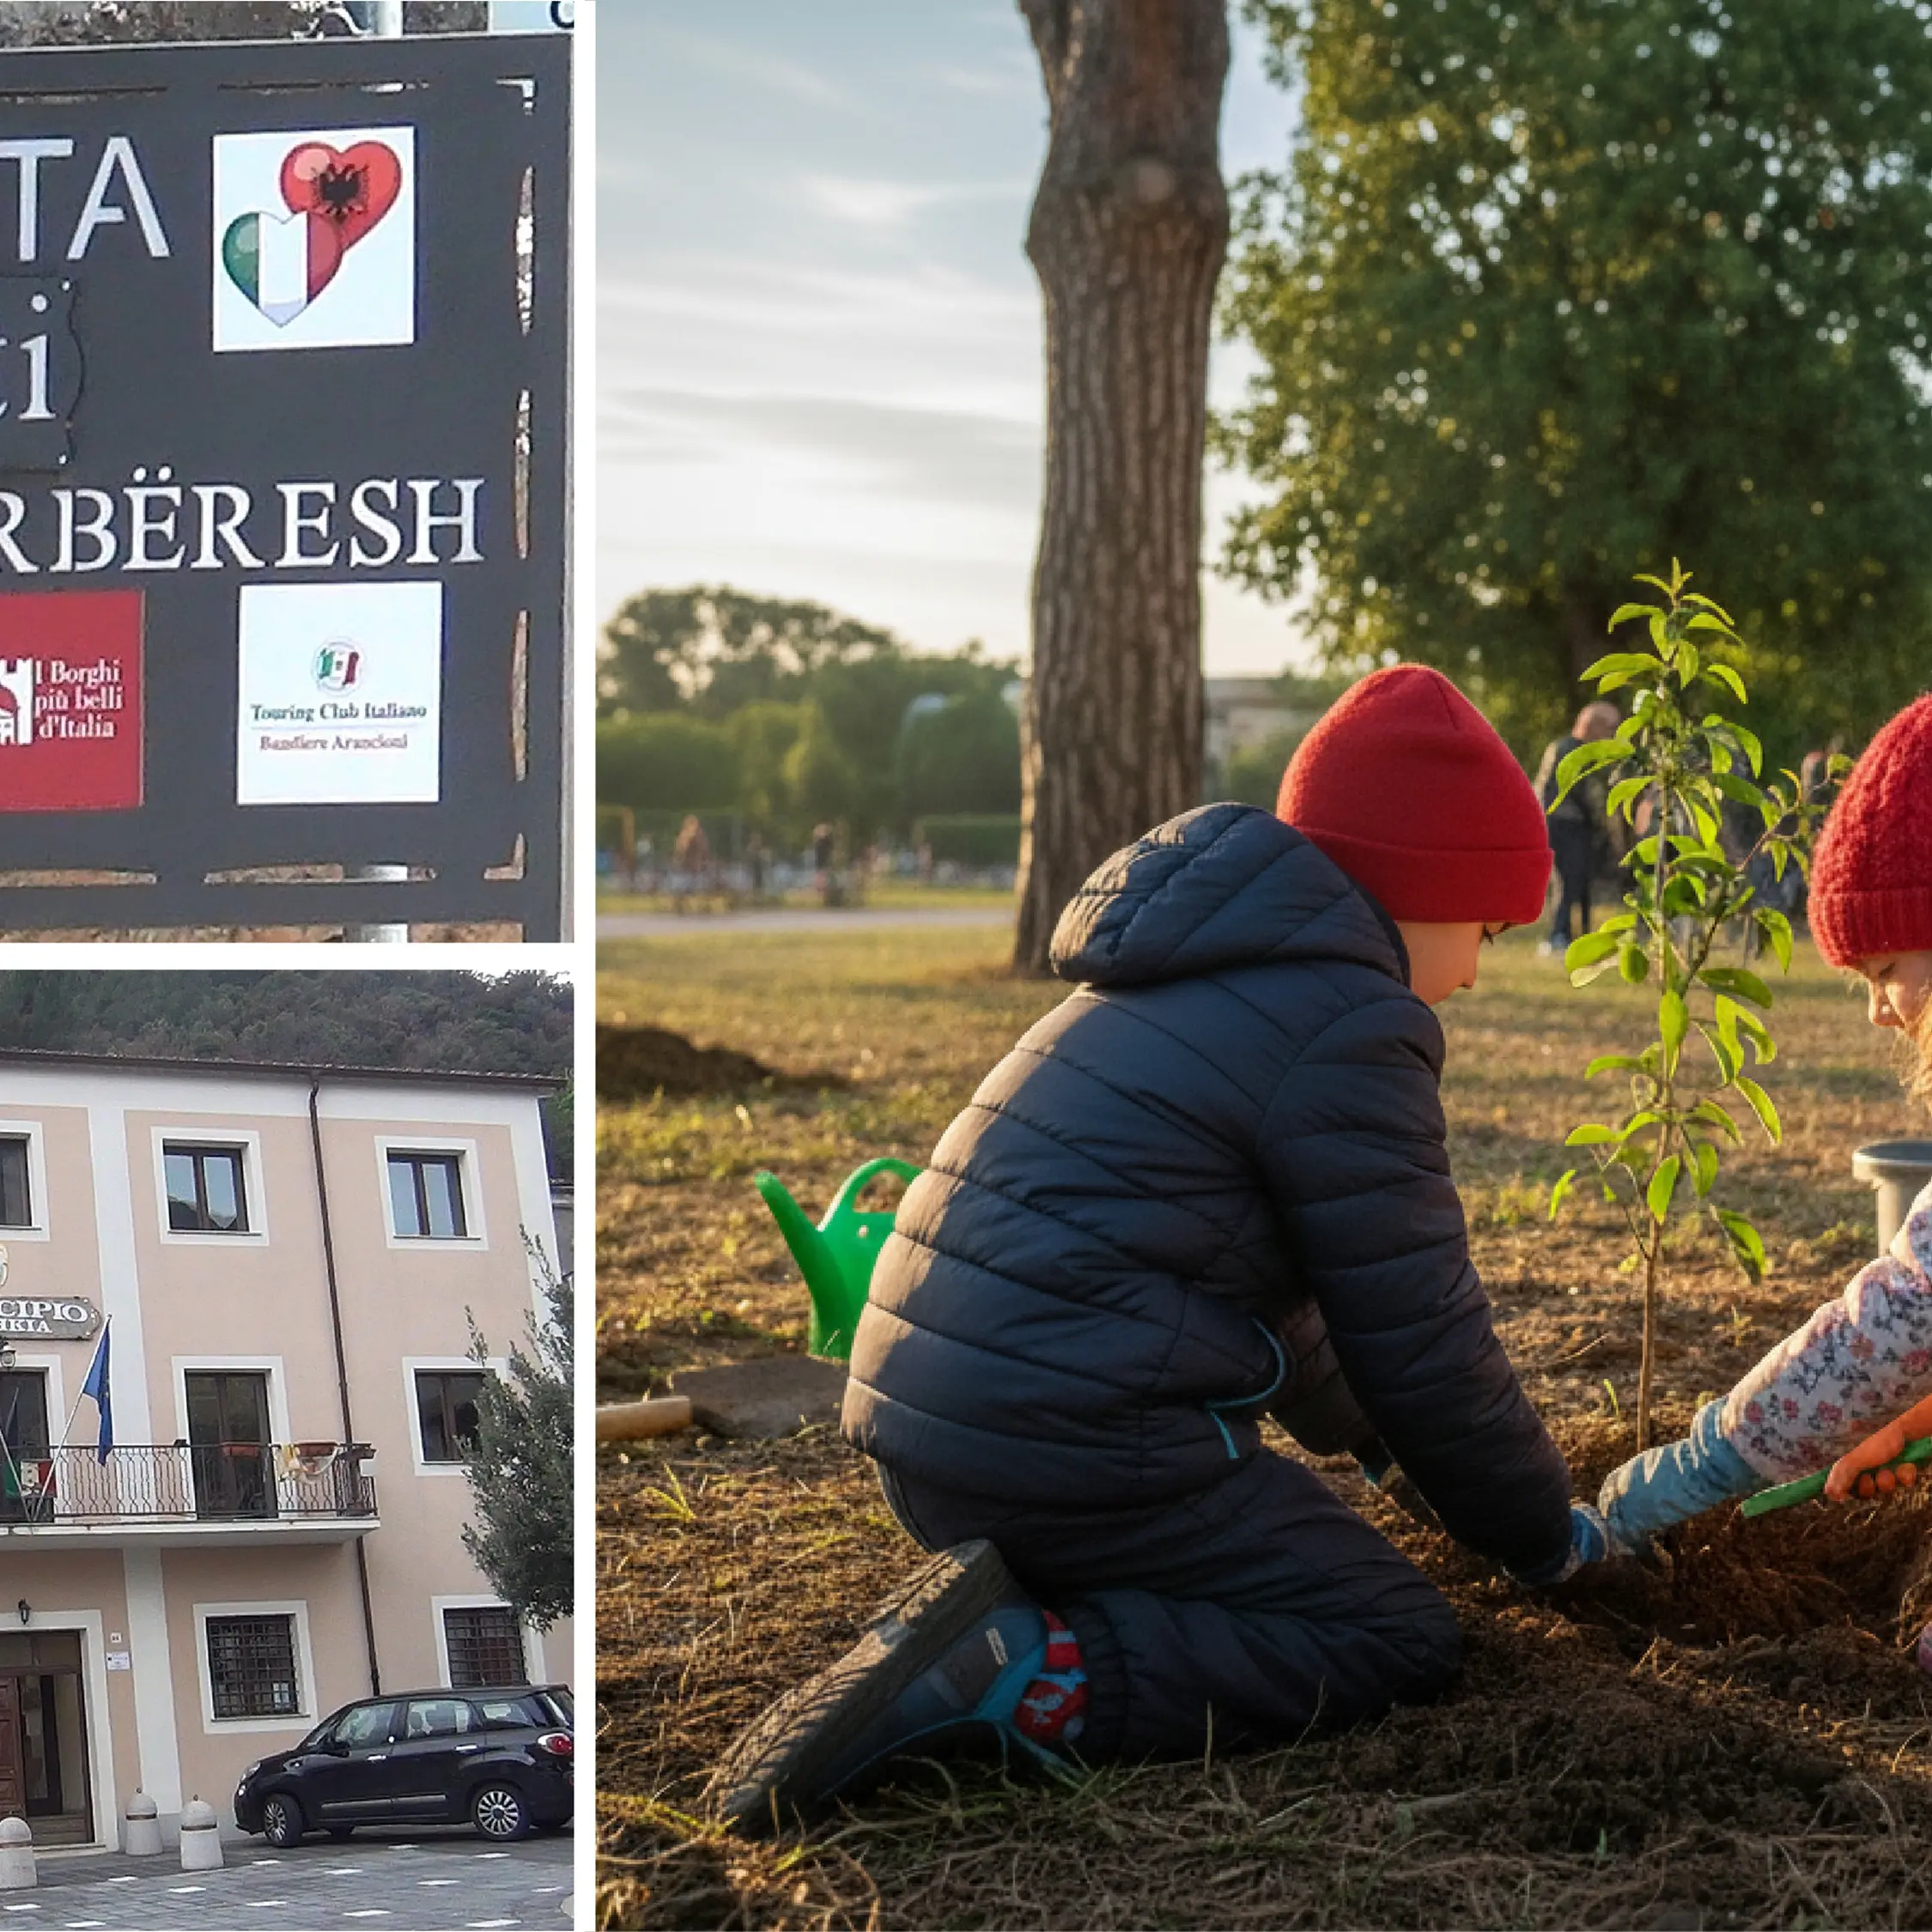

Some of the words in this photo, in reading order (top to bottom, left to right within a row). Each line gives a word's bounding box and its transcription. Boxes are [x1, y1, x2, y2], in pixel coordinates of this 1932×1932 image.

[0, 137, 170, 261] TA
[0, 294, 57, 420] i
[51, 658, 121, 689] Borghi
[34, 688, 69, 719] più
[74, 685, 124, 710] belli
[251, 703, 315, 722] Touring
[319, 702, 360, 720] Club
[364, 702, 428, 720] Italiano
[39, 713, 115, 739] d'Italia
